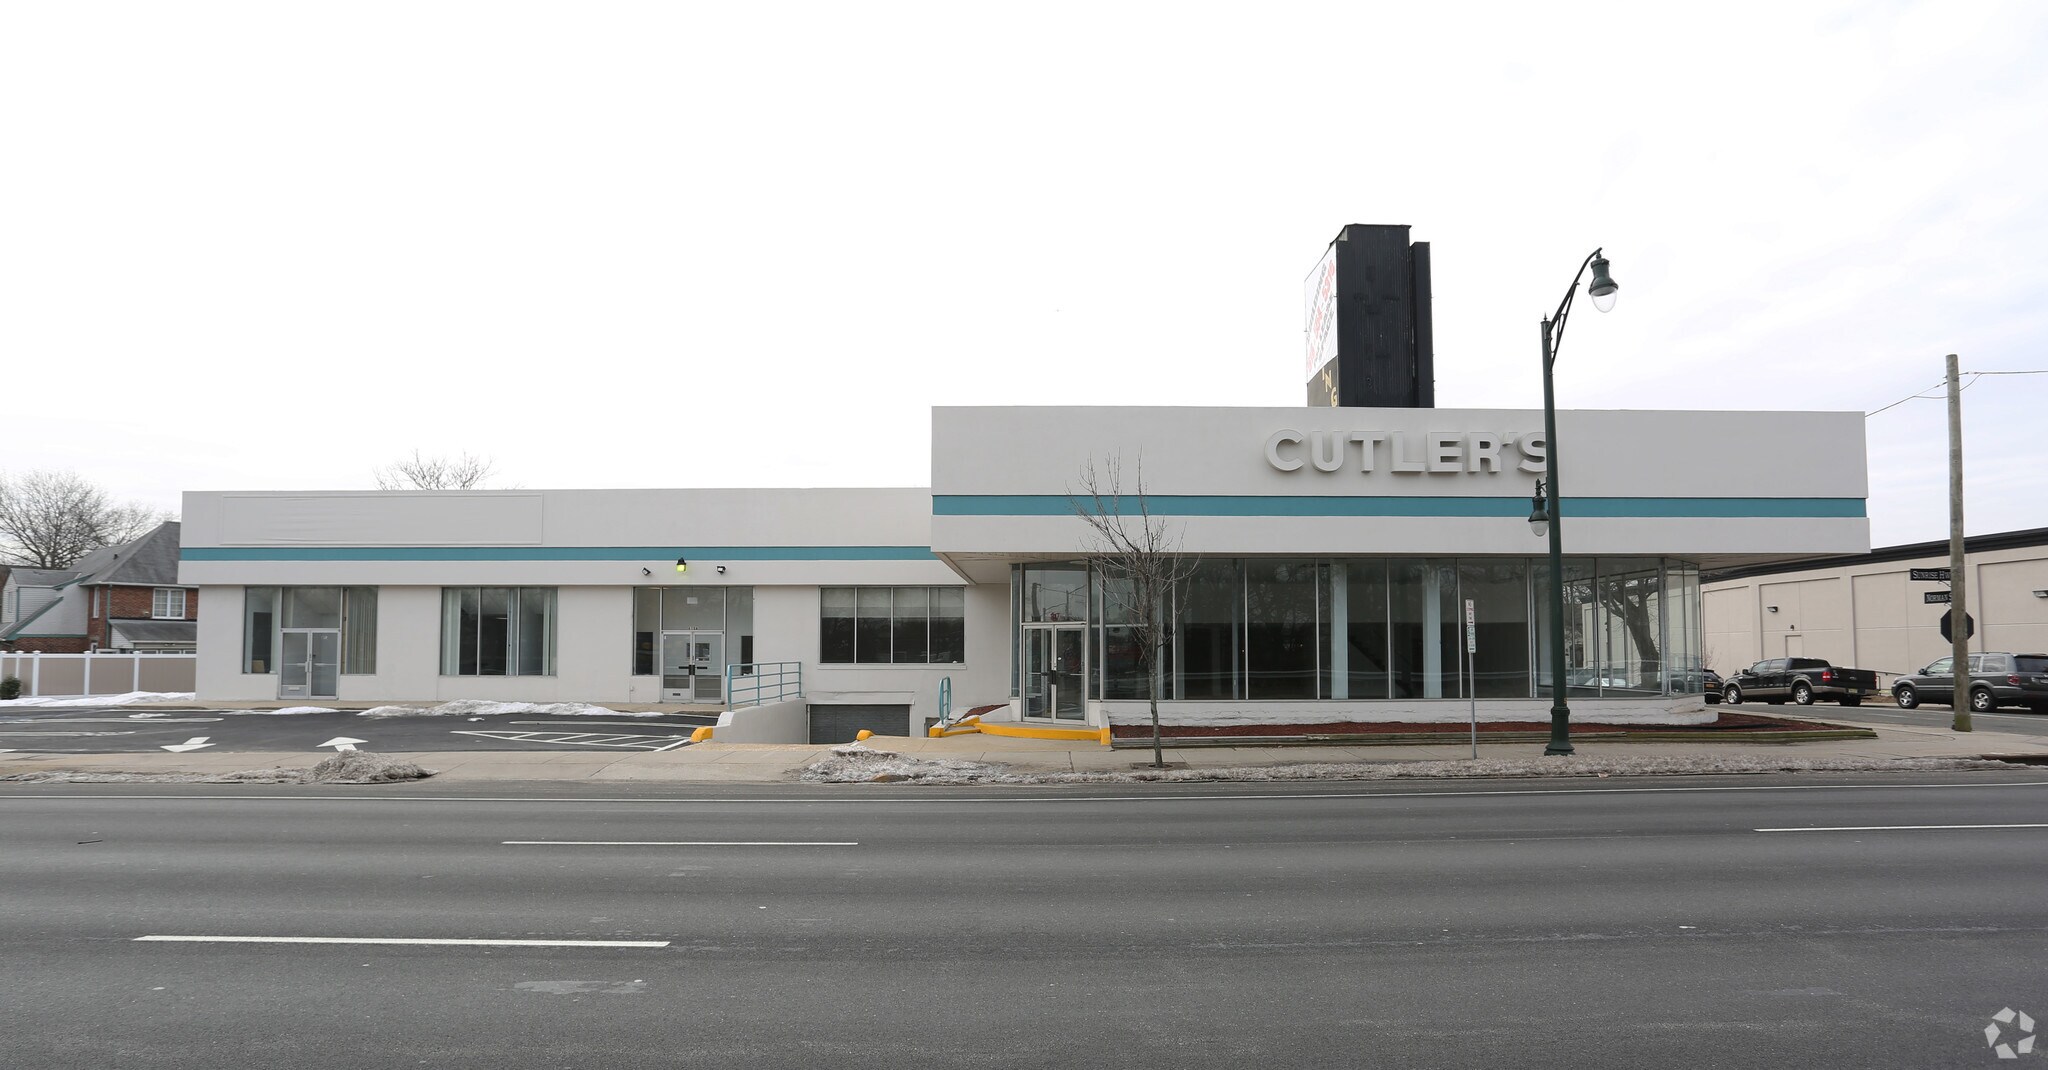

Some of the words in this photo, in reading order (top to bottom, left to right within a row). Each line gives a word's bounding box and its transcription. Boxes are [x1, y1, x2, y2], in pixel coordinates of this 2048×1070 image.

[1265, 428, 1547, 473] CUTLER'S
[1912, 570, 1938, 579] SUNRISE
[1939, 570, 1951, 579] HW
[1926, 594, 1948, 602] NORMAN
